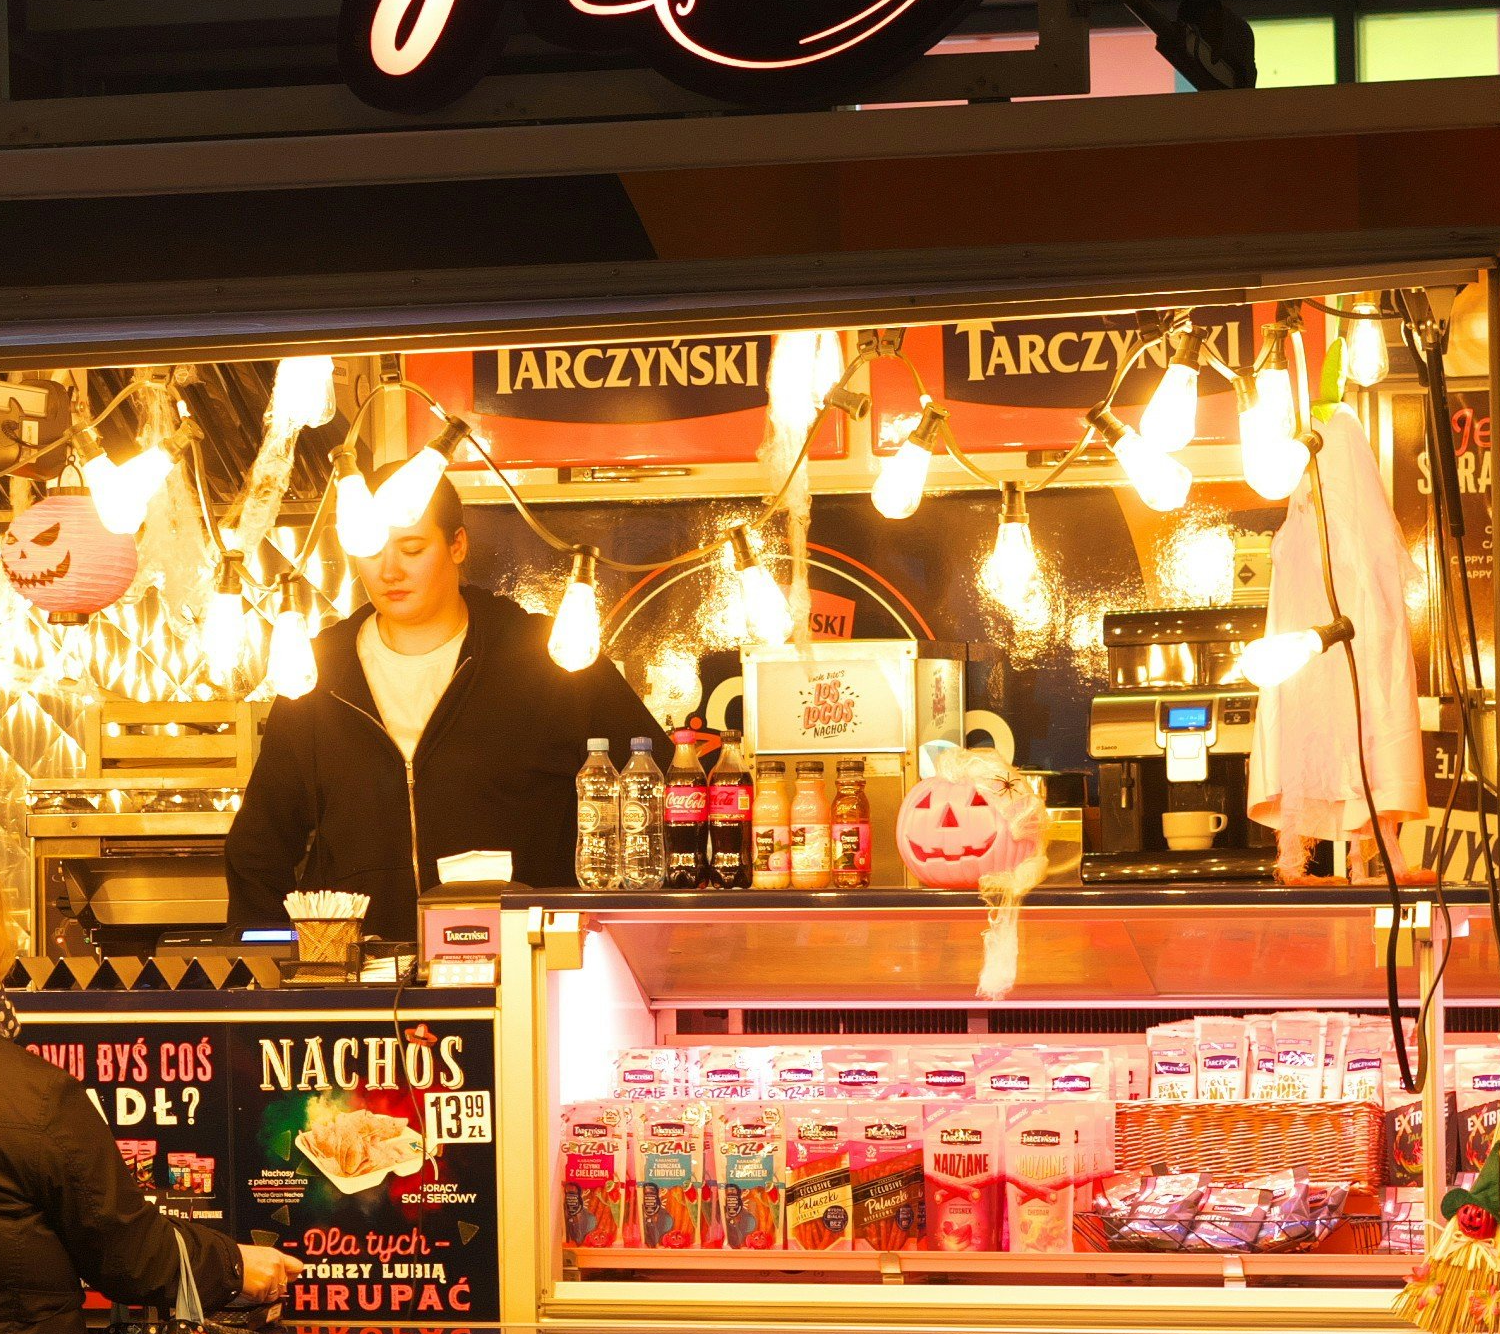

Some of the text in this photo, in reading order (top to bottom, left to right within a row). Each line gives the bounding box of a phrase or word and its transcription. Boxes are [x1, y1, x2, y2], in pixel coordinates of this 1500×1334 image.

[496, 339, 759, 394] TARCZYŃSKI
[814, 679, 841, 706] LOS
[813, 723, 848, 738] NACHOS
[666, 791, 706, 811] Coca-Cola
[445, 930, 488, 941] TARCZYŃSKI
[97, 1037, 148, 1082] BYŚ
[160, 1037, 212, 1082] COŚ
[259, 1036, 464, 1091] NACHOS
[430, 1095, 484, 1139] 13 99
[468, 1126, 486, 1138] ZŁ
[253, 1178, 308, 1187] pełnego ziarna
[261, 1169, 294, 1178] Nachosy
[800, 1180, 831, 1196] EXCLUSIVE
[870, 1180, 902, 1196] EXCLUSIVE
[427, 1193, 477, 1204] SEROWY
[304, 1227, 431, 1263] Dla tych
[382, 1263, 446, 1284] LUBIĄ
[294, 1276, 471, 1311] HRUPAĆ
